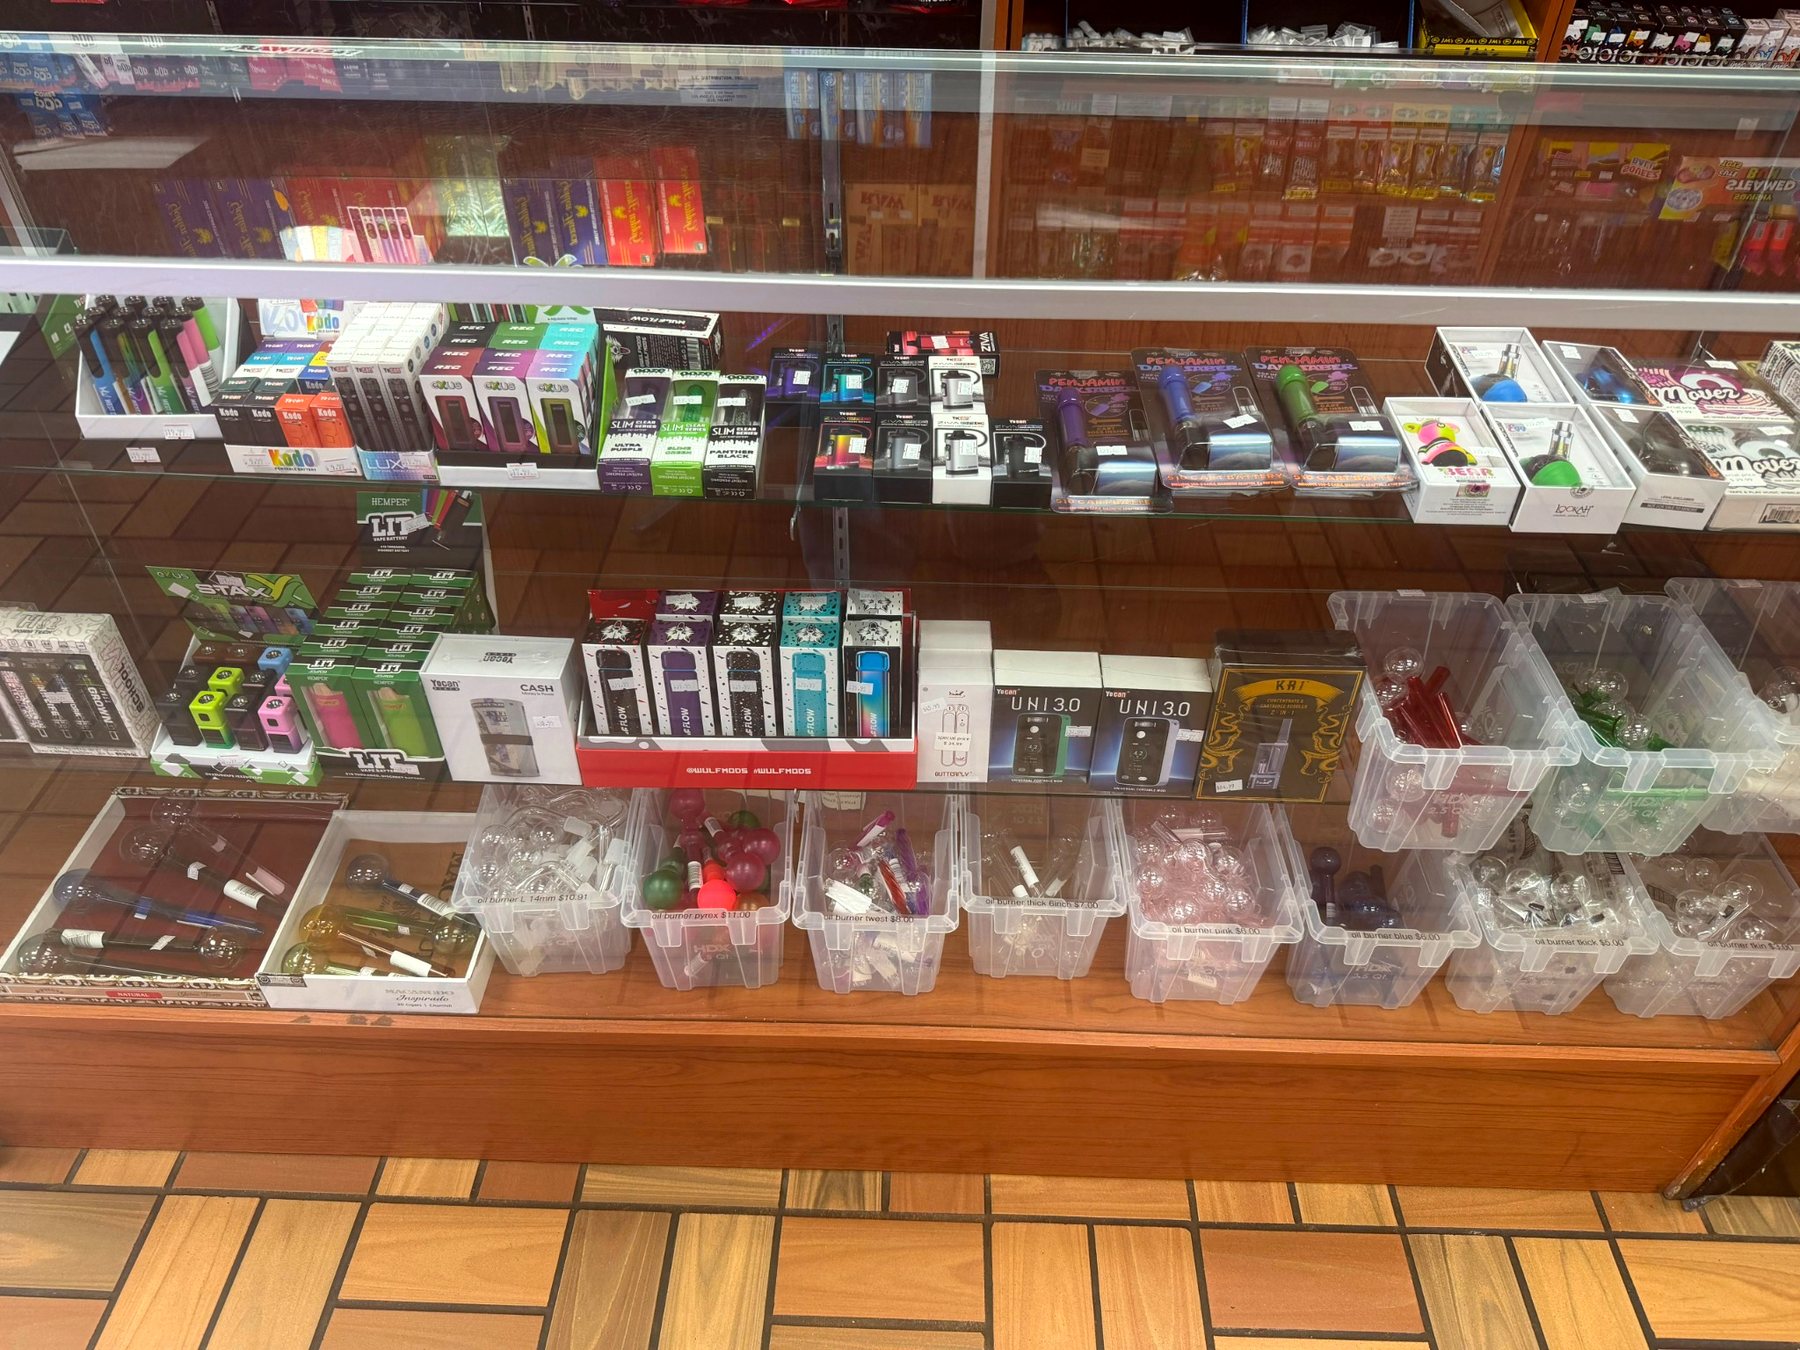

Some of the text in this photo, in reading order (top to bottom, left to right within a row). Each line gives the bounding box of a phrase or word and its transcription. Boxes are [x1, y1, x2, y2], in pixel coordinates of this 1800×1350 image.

[1146, 357, 1226, 366] PENJAMIN
[1260, 355, 1341, 365] PENJAMIN
[1048, 377, 1126, 388] PENJAMIN
[252, 409, 272, 418] Kodo
[282, 411, 302, 421] Kodo
[317, 408, 337, 417] Kodo
[612, 420, 635, 429] SLIM
[661, 424, 685, 432] SLIM
[712, 428, 735, 436] SLIM
[268, 448, 315, 468] Kodo
[371, 497, 408, 507] HEMPER
[1555, 503, 1592, 513] LOOKAH
[371, 515, 411, 538] LIT
[195, 583, 272, 598] STAX
[520, 683, 554, 693] CASH
[996, 688, 1018, 696] Yocan
[1105, 690, 1127, 698] Yocan
[1011, 697, 1081, 713] UNI 3.0
[1119, 699, 1191, 717] UNI 3.0
[619, 706, 628, 728] FLOW
[745, 707, 753, 729] FLOW
[807, 707, 815, 730] FLOW
[870, 711, 878, 731] FLOW
[355, 752, 402, 770] LIT
[686, 767, 812, 775] @WULFMODS #WULFMODS
[477, 896, 488, 904] oil
[489, 896, 518, 904] burner
[530, 894, 556, 902] 14mm
[558, 893, 588, 902] $10.91
[984, 896, 995, 905] oil
[997, 897, 1024, 906] burner
[1026, 898, 1046, 907] thick
[1074, 901, 1099, 910] $7.00
[651, 911, 751, 920] oil burner pyrex $11.00
[823, 913, 834, 921] oil
[835, 913, 862, 921] burner
[890, 915, 914, 924] $8.00
[1171, 925, 1182, 933] oil
[1184, 926, 1212, 934] burner
[1214, 926, 1233, 935] pink
[1351, 931, 1362, 939] oil
[1363, 931, 1392, 940] burner
[1394, 932, 1413, 941] blue
[1546, 938, 1575, 946] burner
[1599, 938, 1624, 947] $5.00
[1707, 940, 1718, 948] oil
[1718, 941, 1749, 949] burner
[396, 994, 450, 1003] Inspirado
